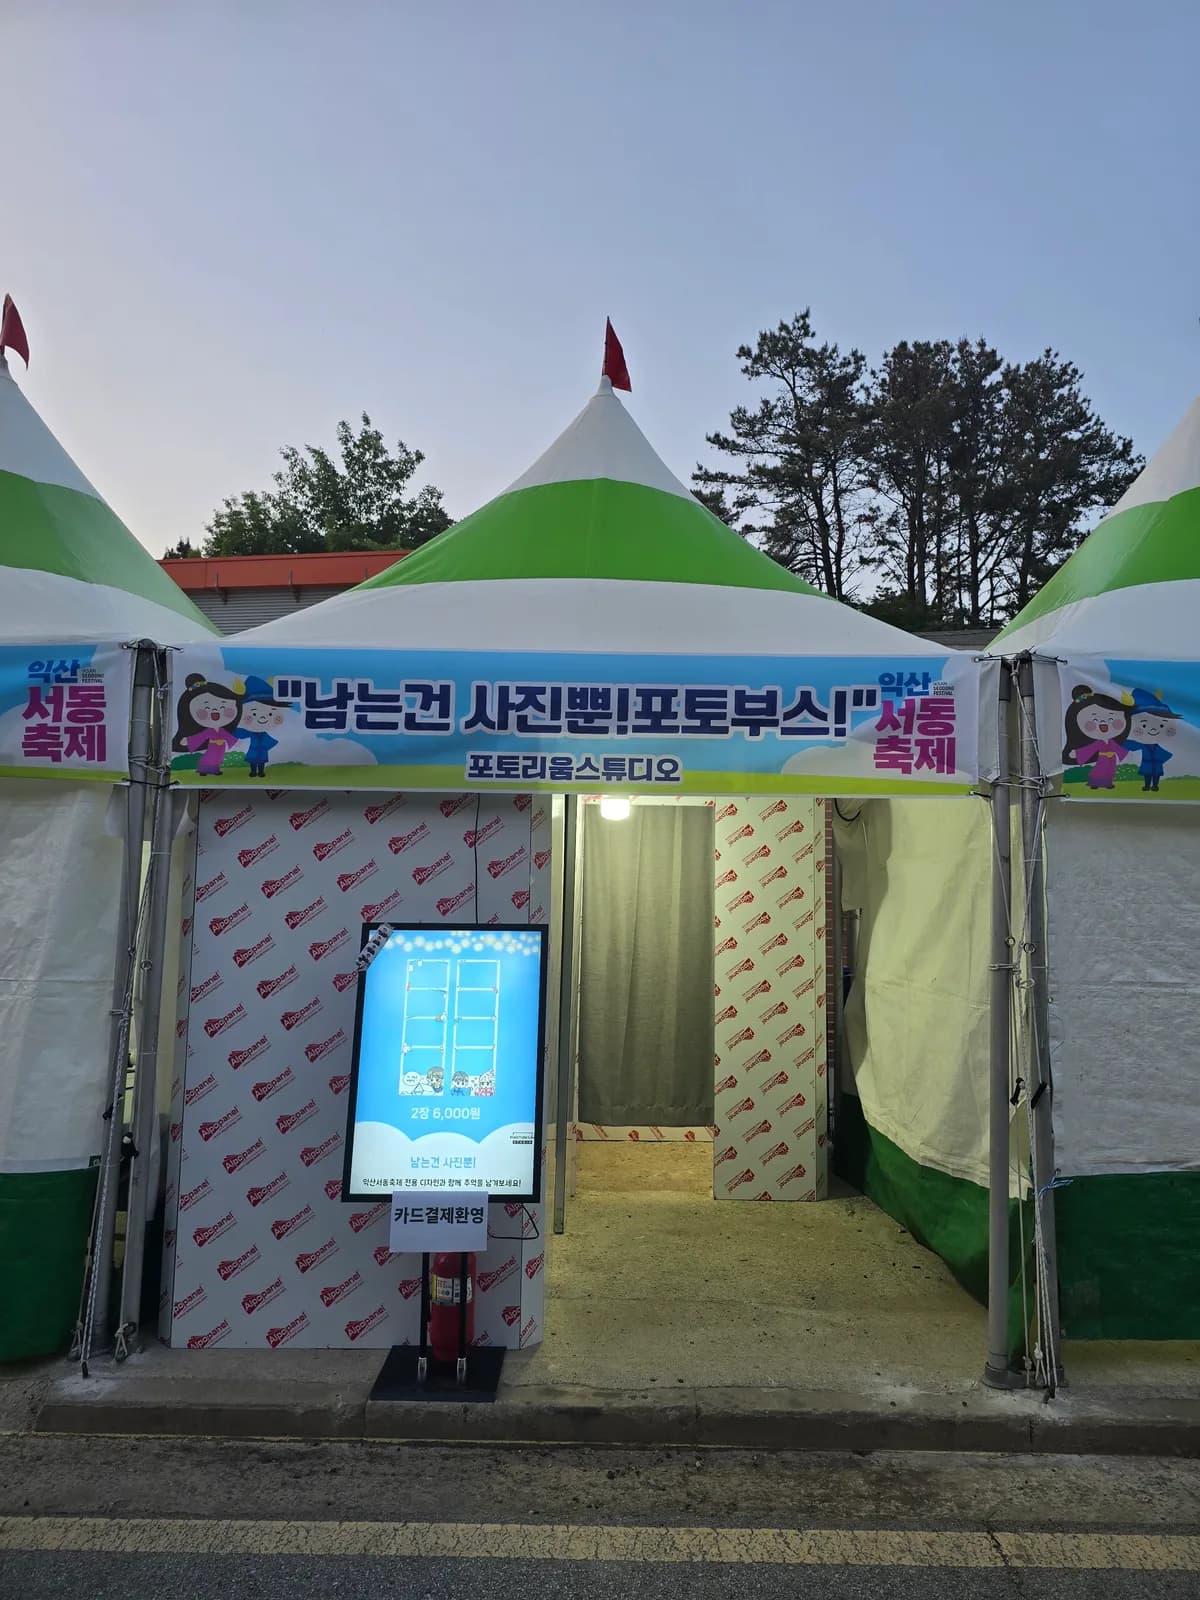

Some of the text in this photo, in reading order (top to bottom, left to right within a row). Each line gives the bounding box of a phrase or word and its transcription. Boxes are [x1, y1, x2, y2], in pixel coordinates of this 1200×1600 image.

[27, 659, 80, 683] 익산
[879, 672, 931, 697] 익산
[22, 685, 106, 723] 서동
[277, 679, 450, 731] "남는건
[875, 697, 957, 736] 서동
[22, 723, 106, 762] 축제
[873, 737, 957, 775] 축제
[468, 754, 681, 781] 포토리움스튜디오
[195, 871, 225, 898] popanel
[190, 972, 220, 998] popanel
[411, 1107, 480, 1120] 2장 6,000원
[410, 1157, 476, 1169] 남는건 사진뿐!
[179, 1179, 209, 1207] popanel
[448, 1178, 461, 1187] 함께
[394, 1206, 485, 1225] 카드결제환영
[173, 1286, 204, 1314] popanel
